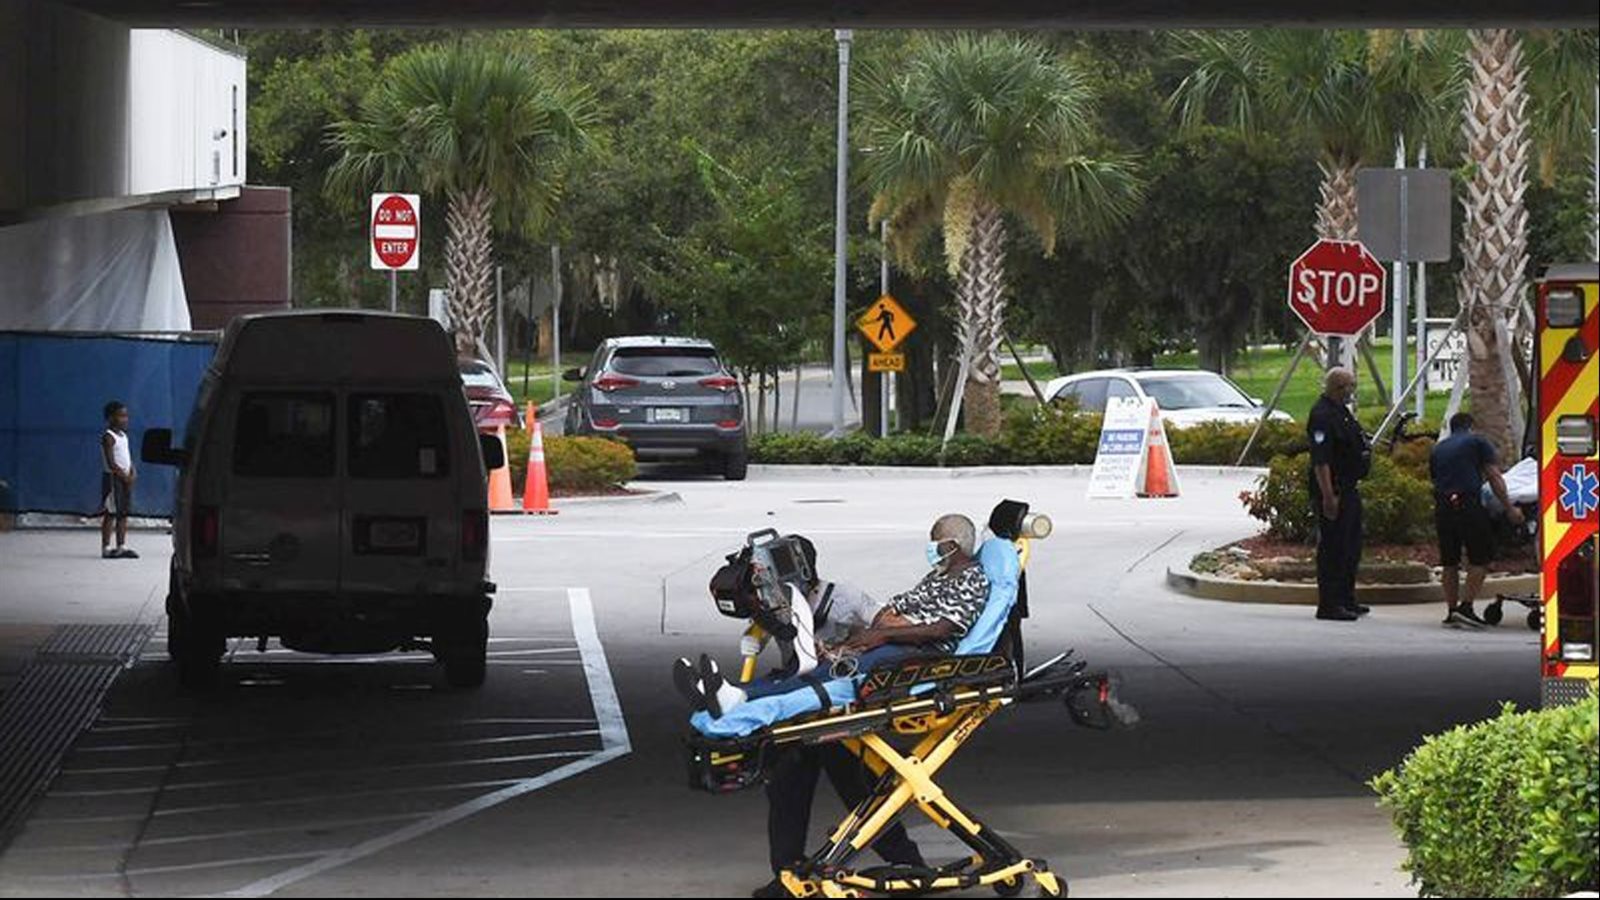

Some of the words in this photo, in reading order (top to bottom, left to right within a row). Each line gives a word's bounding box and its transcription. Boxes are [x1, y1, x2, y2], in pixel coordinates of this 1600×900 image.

[379, 209, 392, 221] DO
[396, 209, 412, 222] NOT
[382, 242, 408, 254] ENTER
[1297, 268, 1379, 307] STOP
[872, 357, 902, 367] AHEAD
